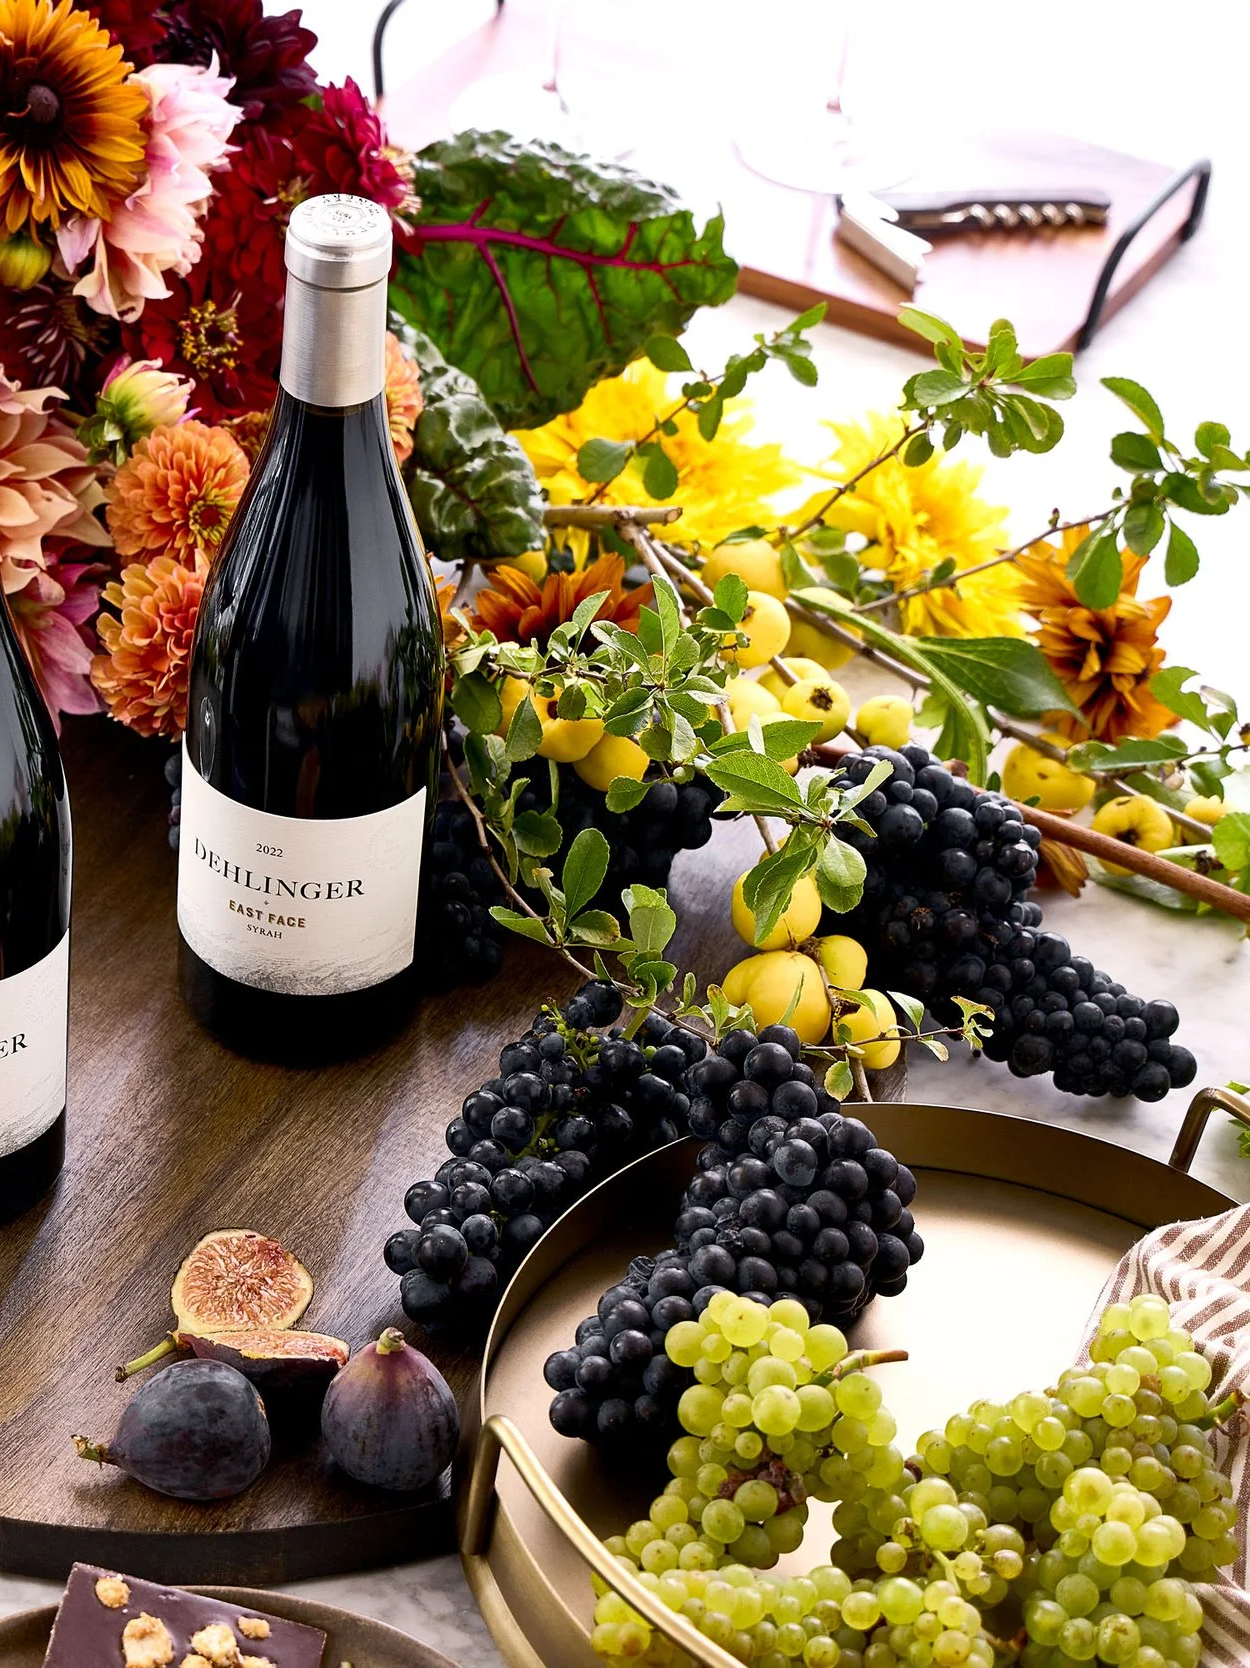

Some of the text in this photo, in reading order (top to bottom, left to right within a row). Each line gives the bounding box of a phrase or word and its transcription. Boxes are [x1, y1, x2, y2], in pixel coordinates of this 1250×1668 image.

[256, 843, 284, 858] 2022
[194, 837, 365, 900] DEHLINGER
[228, 899, 307, 929] EAST FACE
[246, 923, 283, 940] SYRAH
